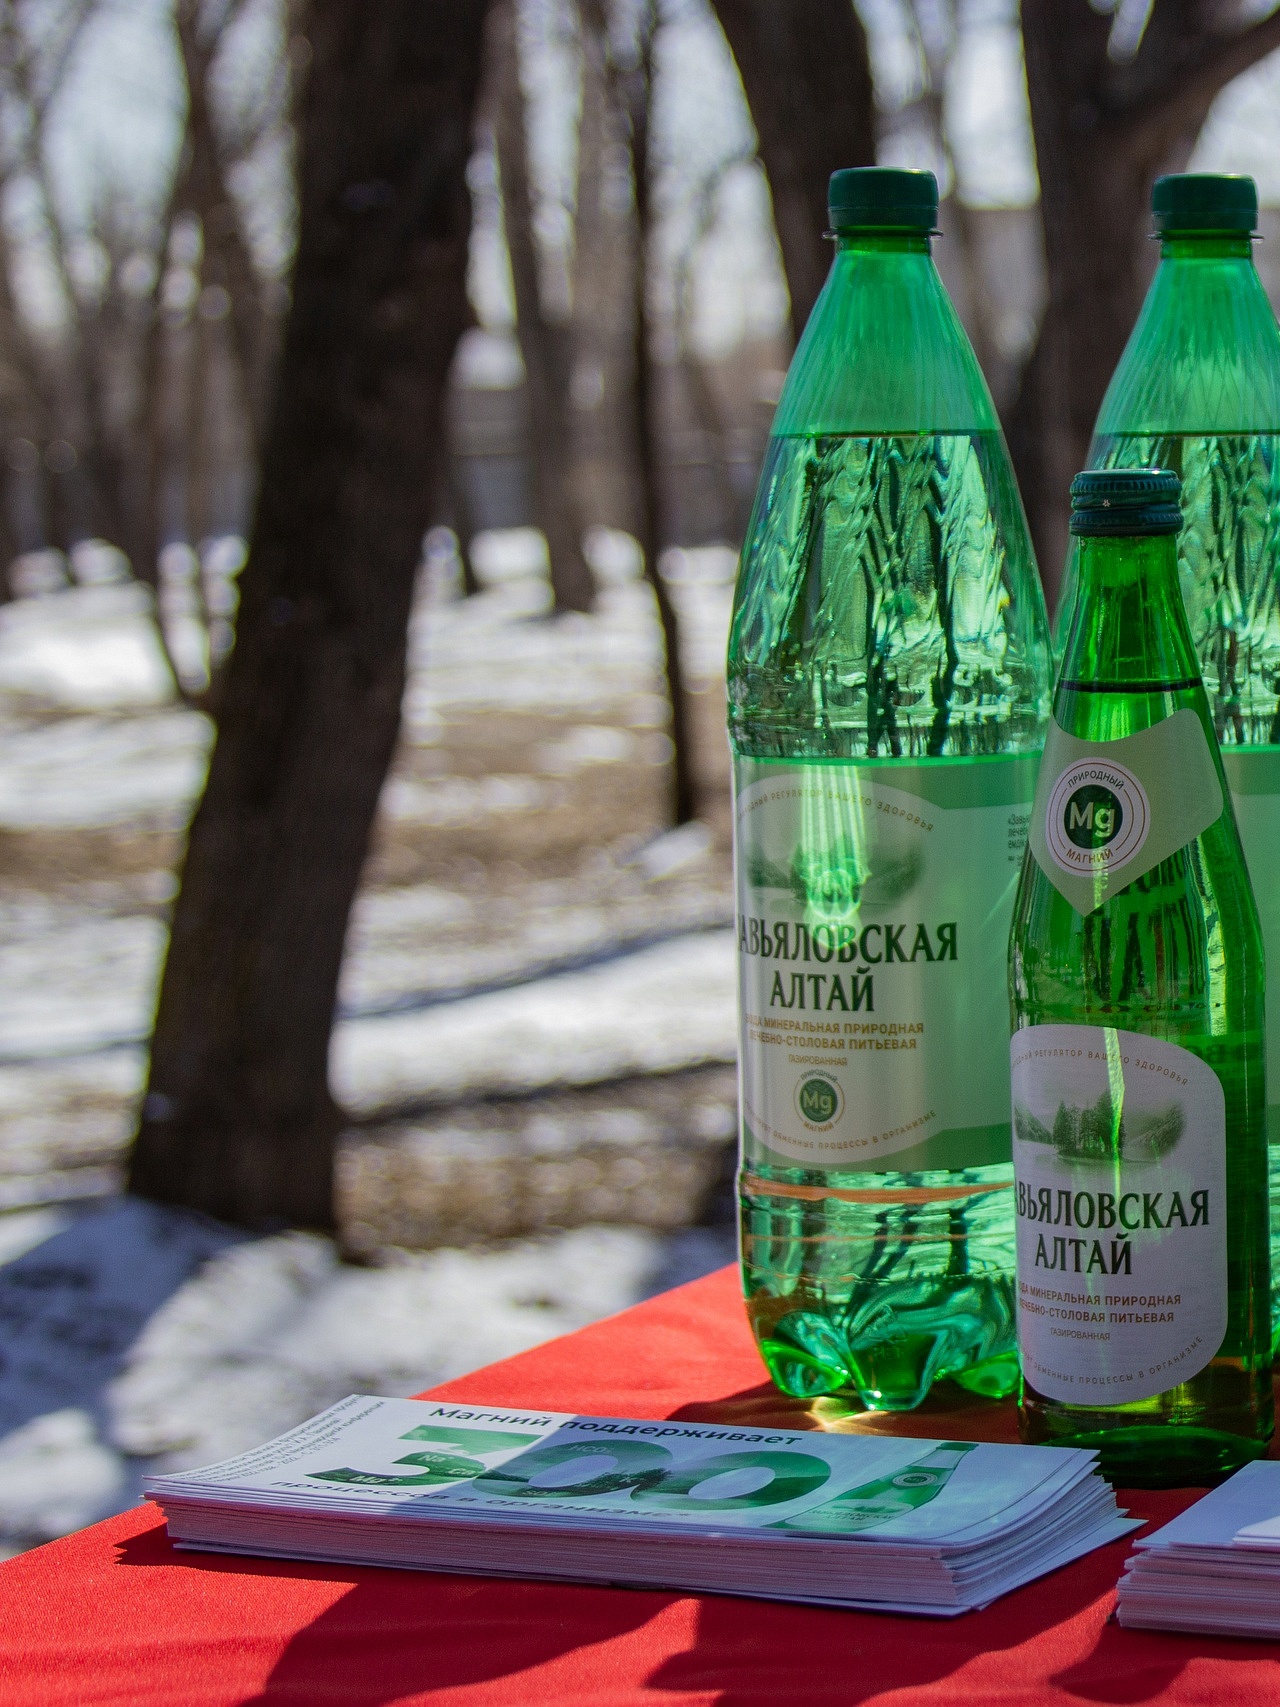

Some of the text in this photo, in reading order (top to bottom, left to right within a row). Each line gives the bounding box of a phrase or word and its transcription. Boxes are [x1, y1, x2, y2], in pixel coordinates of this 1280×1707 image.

[1067, 770, 1125, 790] ПРИРОДНЫЙ
[876, 801, 935, 832] ЗДОРОВЬЯ
[1069, 801, 1115, 838] Mg
[1066, 848, 1114, 863] МАГНИЙ
[739, 914, 959, 963] АВЬЯЛОВСКАЯ
[769, 965, 875, 1012] АЛТАЙ
[764, 1018, 840, 1034] МИНЕРАЛЬНАЯ
[843, 1022, 924, 1037] ПРИРОДНАЯ
[849, 1038, 918, 1051] ПИТЬЕВАЯ
[788, 1053, 849, 1067] ГАЗИРОВАННАЯ
[800, 1068, 838, 1084] ПРИРОДНЫЙ
[1135, 1060, 1188, 1087] ЗДОРОВЬЯ
[803, 1089, 834, 1116] Mg
[803, 1120, 835, 1133] МАГНИЙ
[818, 1139, 869, 1150] ПРОЦЕССЫ
[872, 1135, 879, 1144] В
[882, 1110, 937, 1141] ОРГАНИЗМЕ
[1016, 1179, 1210, 1230] ВЬЯЛОВСКАЯ
[1035, 1232, 1132, 1275] АЛТАЙ
[1030, 1285, 1101, 1306] МИНЕРАЛЬНАЯ
[1105, 1294, 1181, 1307] ПРИРОДНАЯ
[1109, 1312, 1175, 1323] ПИТЬЕВАЯ
[1050, 1327, 1110, 1341] ГАЗИРОВАННАЯ
[1078, 1373, 1133, 1385] ПРОЦЕССЫ
[1138, 1370, 1145, 1379] В
[1149, 1336, 1204, 1375] ОРГАНИЗМЕ
[428, 1407, 804, 1446] Магний поддерживает
[270, 1480, 449, 1501] процессов
[458, 1495, 476, 1503] в
